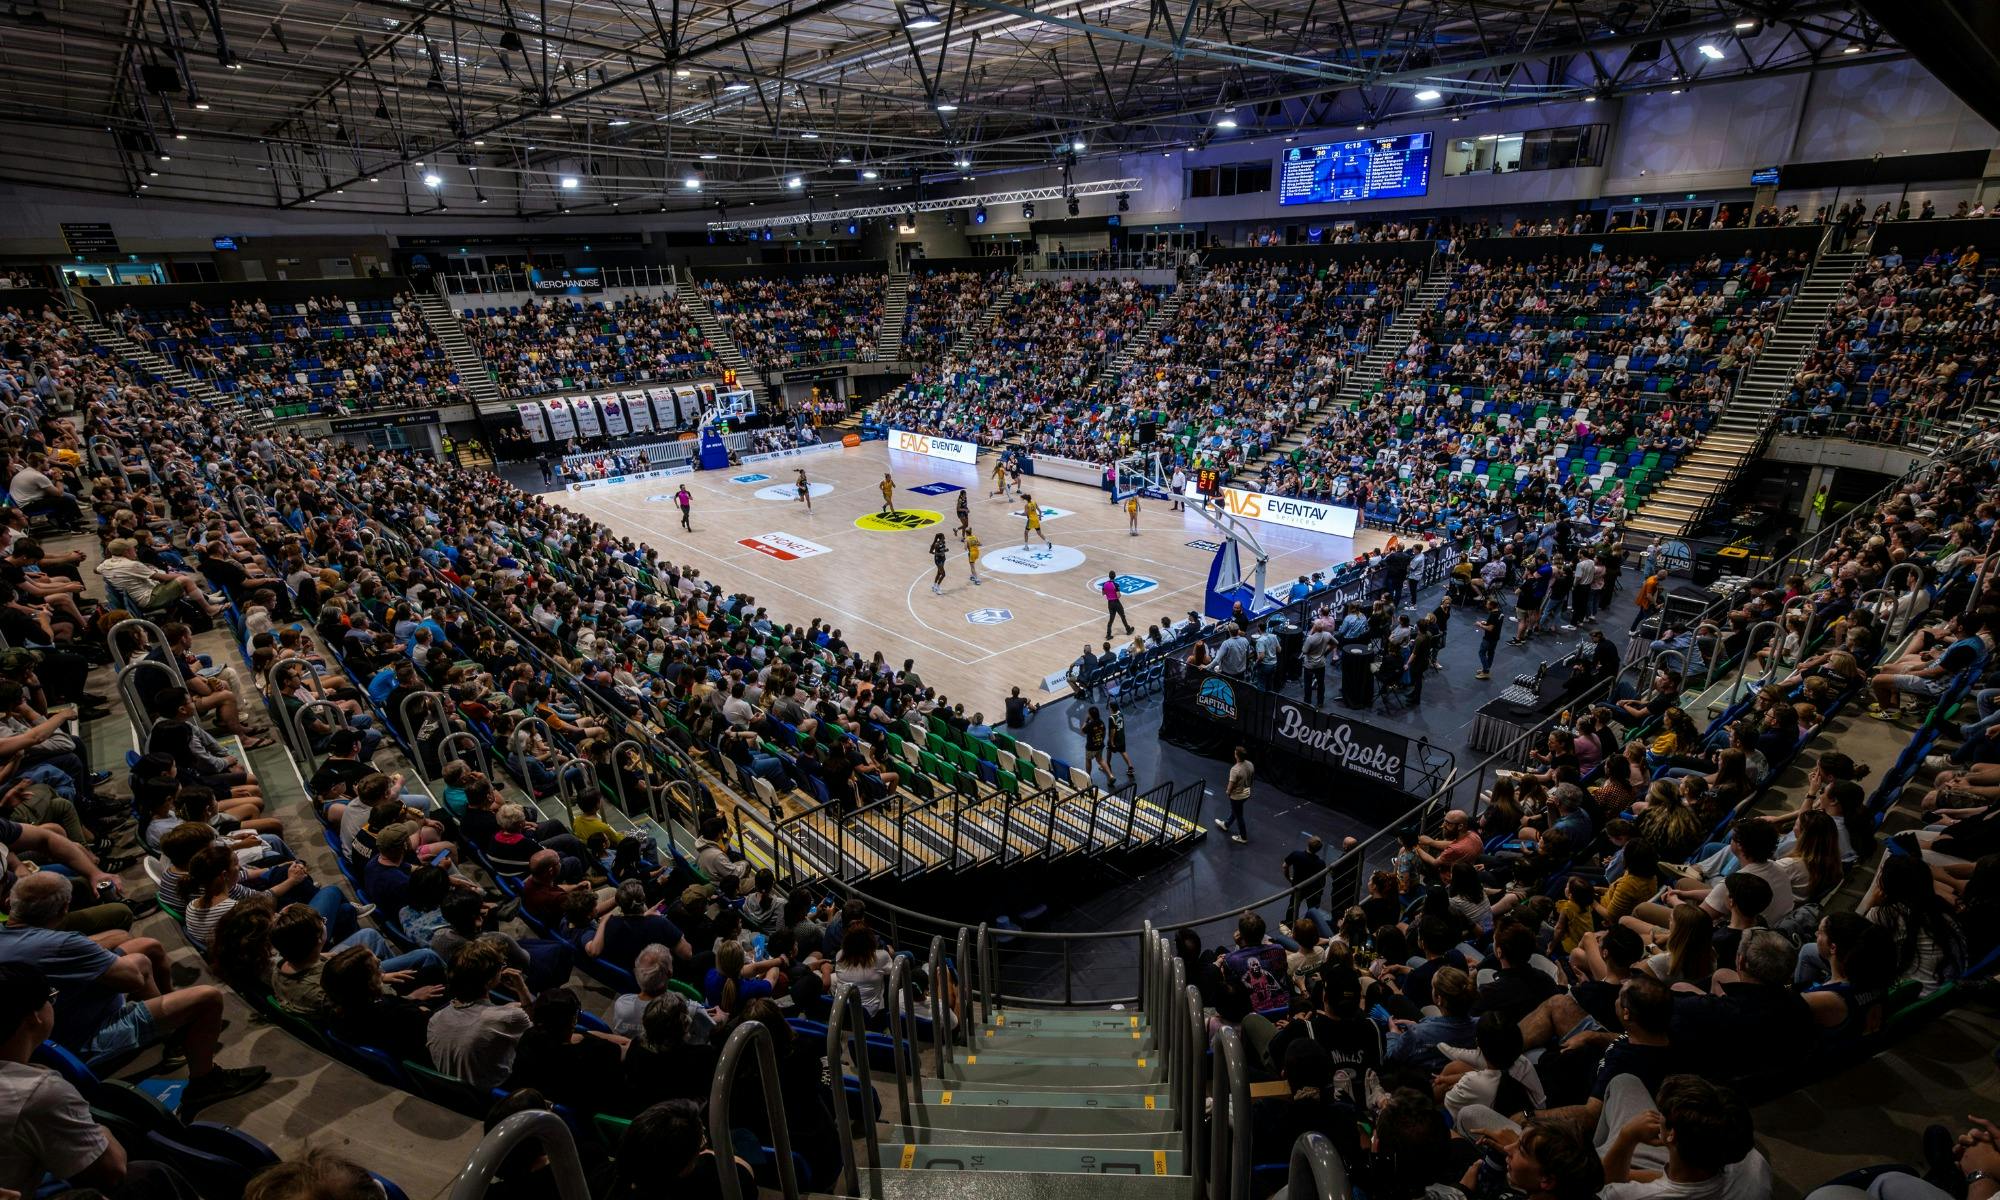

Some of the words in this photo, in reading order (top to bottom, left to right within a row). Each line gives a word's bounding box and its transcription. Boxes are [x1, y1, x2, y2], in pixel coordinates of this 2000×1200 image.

[1345, 142, 1362, 150] 6:15
[535, 278, 600, 289] MERCHANDISE
[900, 432, 929, 454] EAVS
[932, 440, 963, 453] EVENTAV
[1268, 500, 1329, 520] EVENTAV
[762, 534, 818, 554] CYGNETT
[1198, 695, 1235, 715] CAPITALS
[1278, 705, 1401, 775] BentSpoke
[1348, 763, 1382, 781] BREWING
[1384, 774, 1398, 784] CO.
